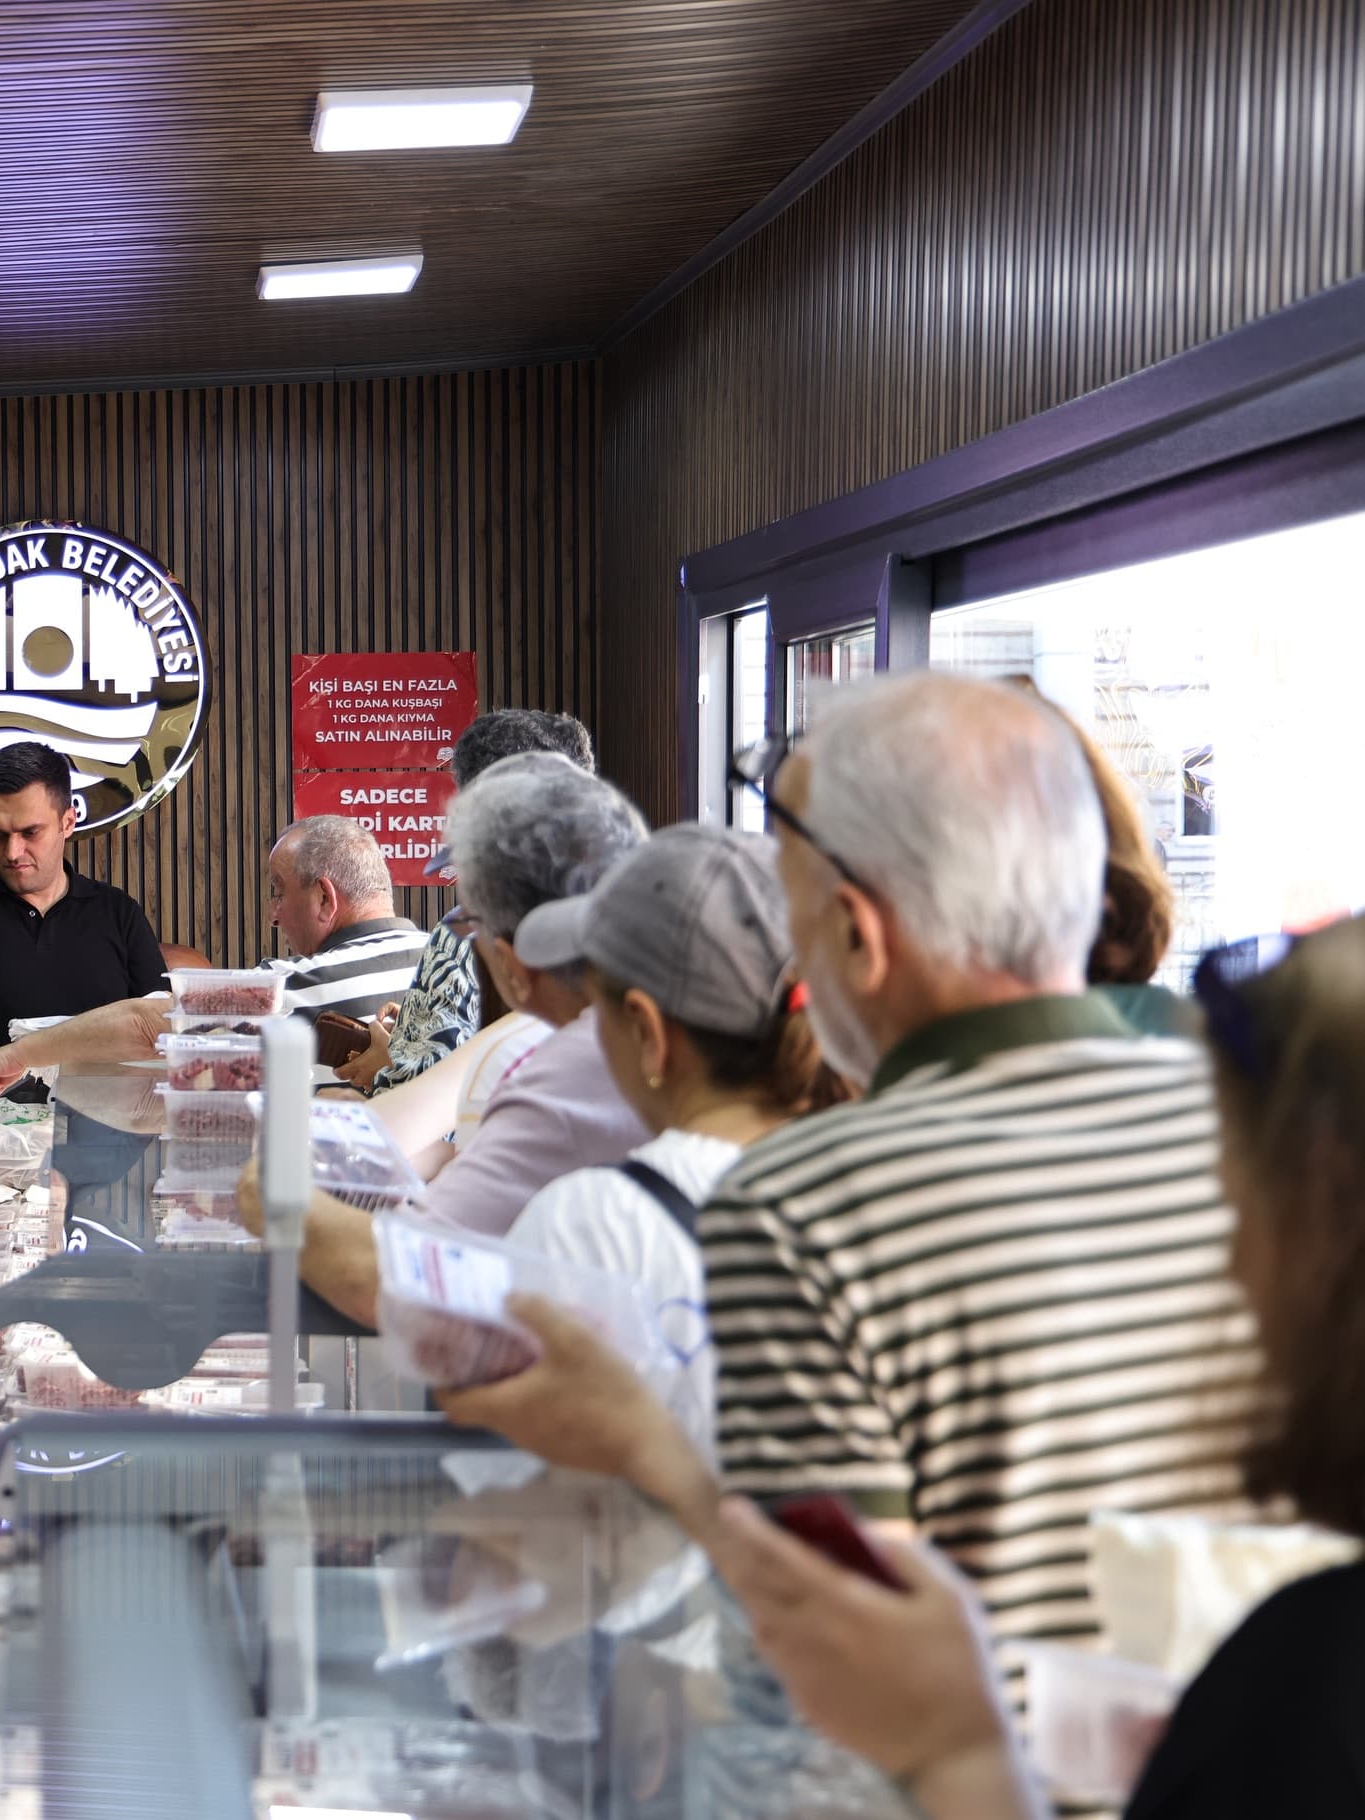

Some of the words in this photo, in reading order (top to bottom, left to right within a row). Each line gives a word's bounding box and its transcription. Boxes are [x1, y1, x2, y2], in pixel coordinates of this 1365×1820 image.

[61, 538, 199, 683] BELEDİYESİ
[309, 678, 338, 695] KİŞİ
[342, 680, 378, 695] BAŞI
[383, 680, 403, 692] EN
[408, 679, 458, 691] FAZLA
[327, 699, 332, 709] 1
[335, 699, 352, 709] KG
[355, 699, 389, 708] DANA
[392, 698, 443, 710] KUŞBAŞI
[333, 714, 337, 724] 1
[340, 714, 357, 724] KG
[360, 714, 395, 723] DANA
[397, 713, 435, 723] KIYMA
[315, 731, 361, 743] SATIN
[364, 726, 452, 742] ALINABİLİR
[340, 788, 428, 805] SADECE
[378, 838, 448, 859] RLİDİ
